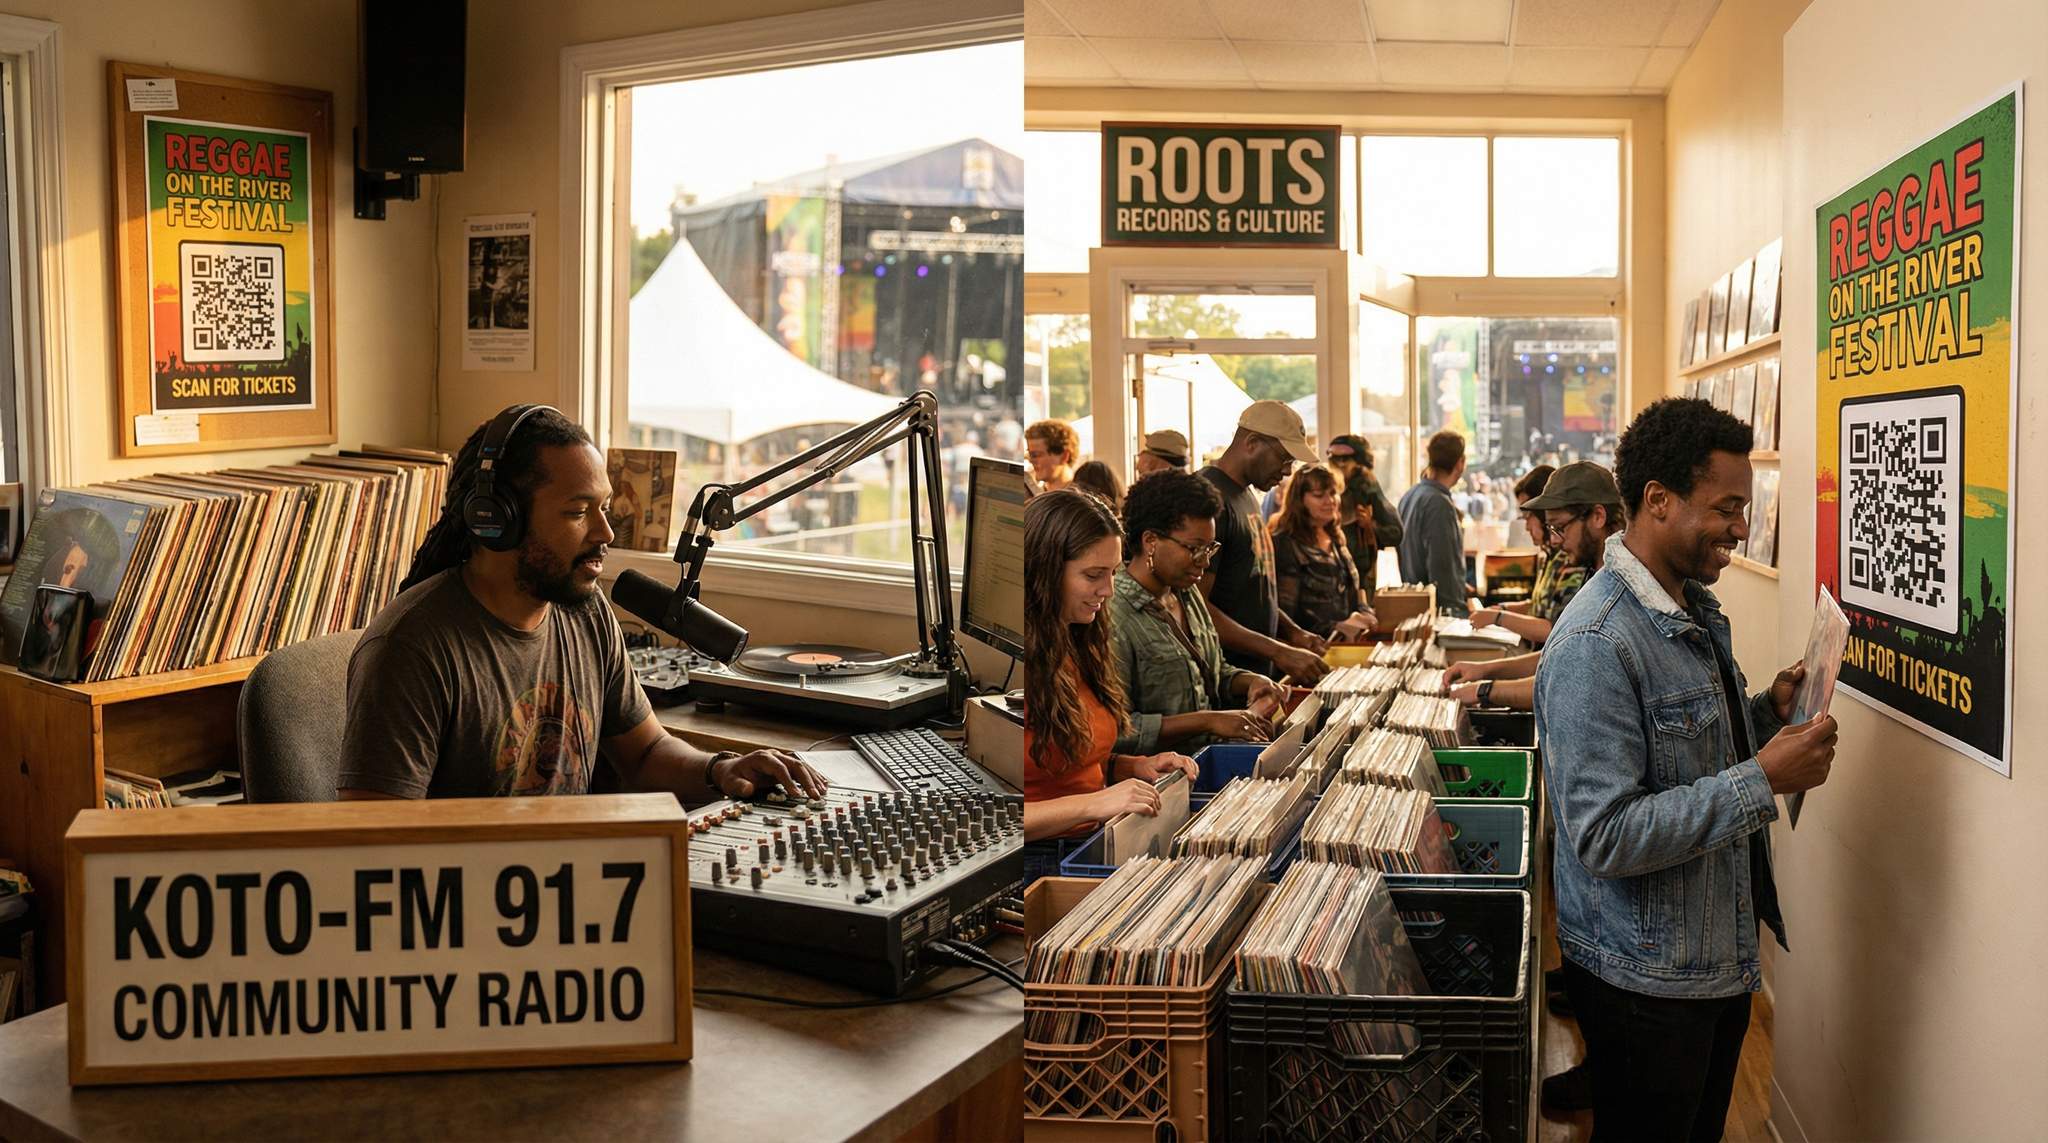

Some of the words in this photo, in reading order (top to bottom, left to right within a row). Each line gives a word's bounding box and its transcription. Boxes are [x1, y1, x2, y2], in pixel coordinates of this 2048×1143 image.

[165, 133, 292, 179] REGGAE
[166, 172, 194, 195] ON
[200, 175, 235, 197] THE
[239, 178, 292, 201] RIVER
[1117, 136, 1326, 206] ROOTS
[167, 196, 293, 233] FESTIVAL
[1117, 208, 1212, 233] RECORDS
[1216, 208, 1232, 233] &
[1236, 209, 1326, 234] CULTURE
[1829, 137, 1984, 281] REGGAE
[1828, 279, 1856, 324] ON
[1858, 261, 1899, 314] THE
[1904, 231, 1984, 302] RIVER
[1829, 287, 1983, 380] FESTIVAL
[172, 378, 210, 398] SCAN
[214, 377, 240, 396] FOR
[242, 376, 297, 395] TICKETS
[1842, 635, 1864, 669] AN
[1868, 640, 1897, 684] FOR
[1900, 653, 1973, 715] TICKETS
[113, 866, 465, 961] KOTO-FM
[494, 861, 647, 948] 91.7
[113, 972, 458, 1042] COMMUNITY
[477, 966, 645, 1027] RADIO
